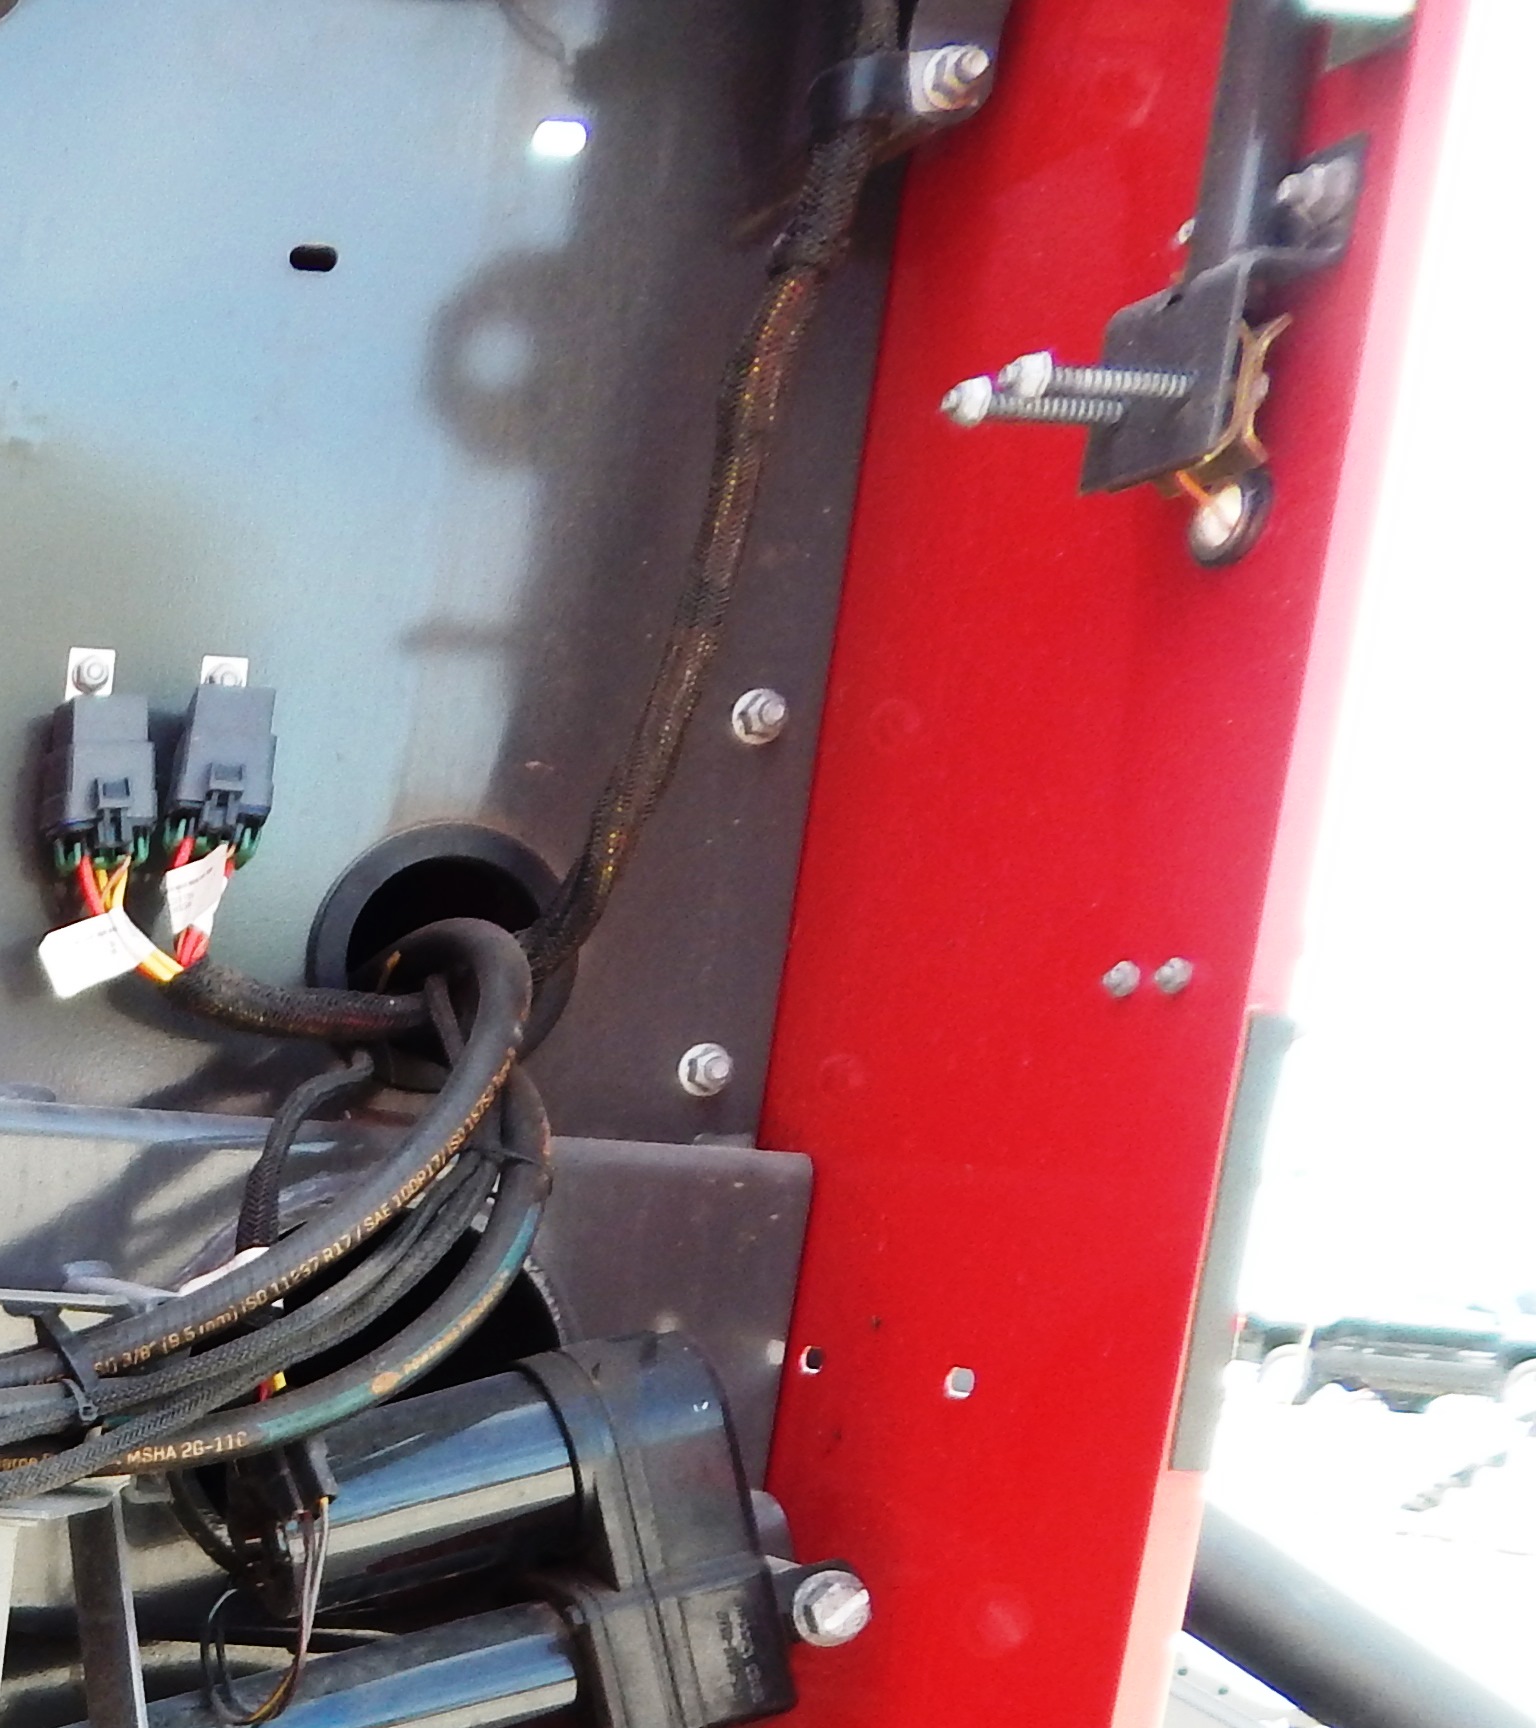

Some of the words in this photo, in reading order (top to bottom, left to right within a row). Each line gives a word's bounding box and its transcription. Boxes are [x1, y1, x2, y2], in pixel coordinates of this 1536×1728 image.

[121, 1339, 156, 1369] 3/8"
[199, 1305, 239, 1335] mm)
[240, 1289, 268, 1314] ISO
[270, 1257, 320, 1294] 11237
[323, 1233, 353, 1263] R17
[363, 1202, 393, 1232] SAE
[127, 1444, 178, 1464] MSHA
[180, 1430, 249, 1457] 2G-11C
